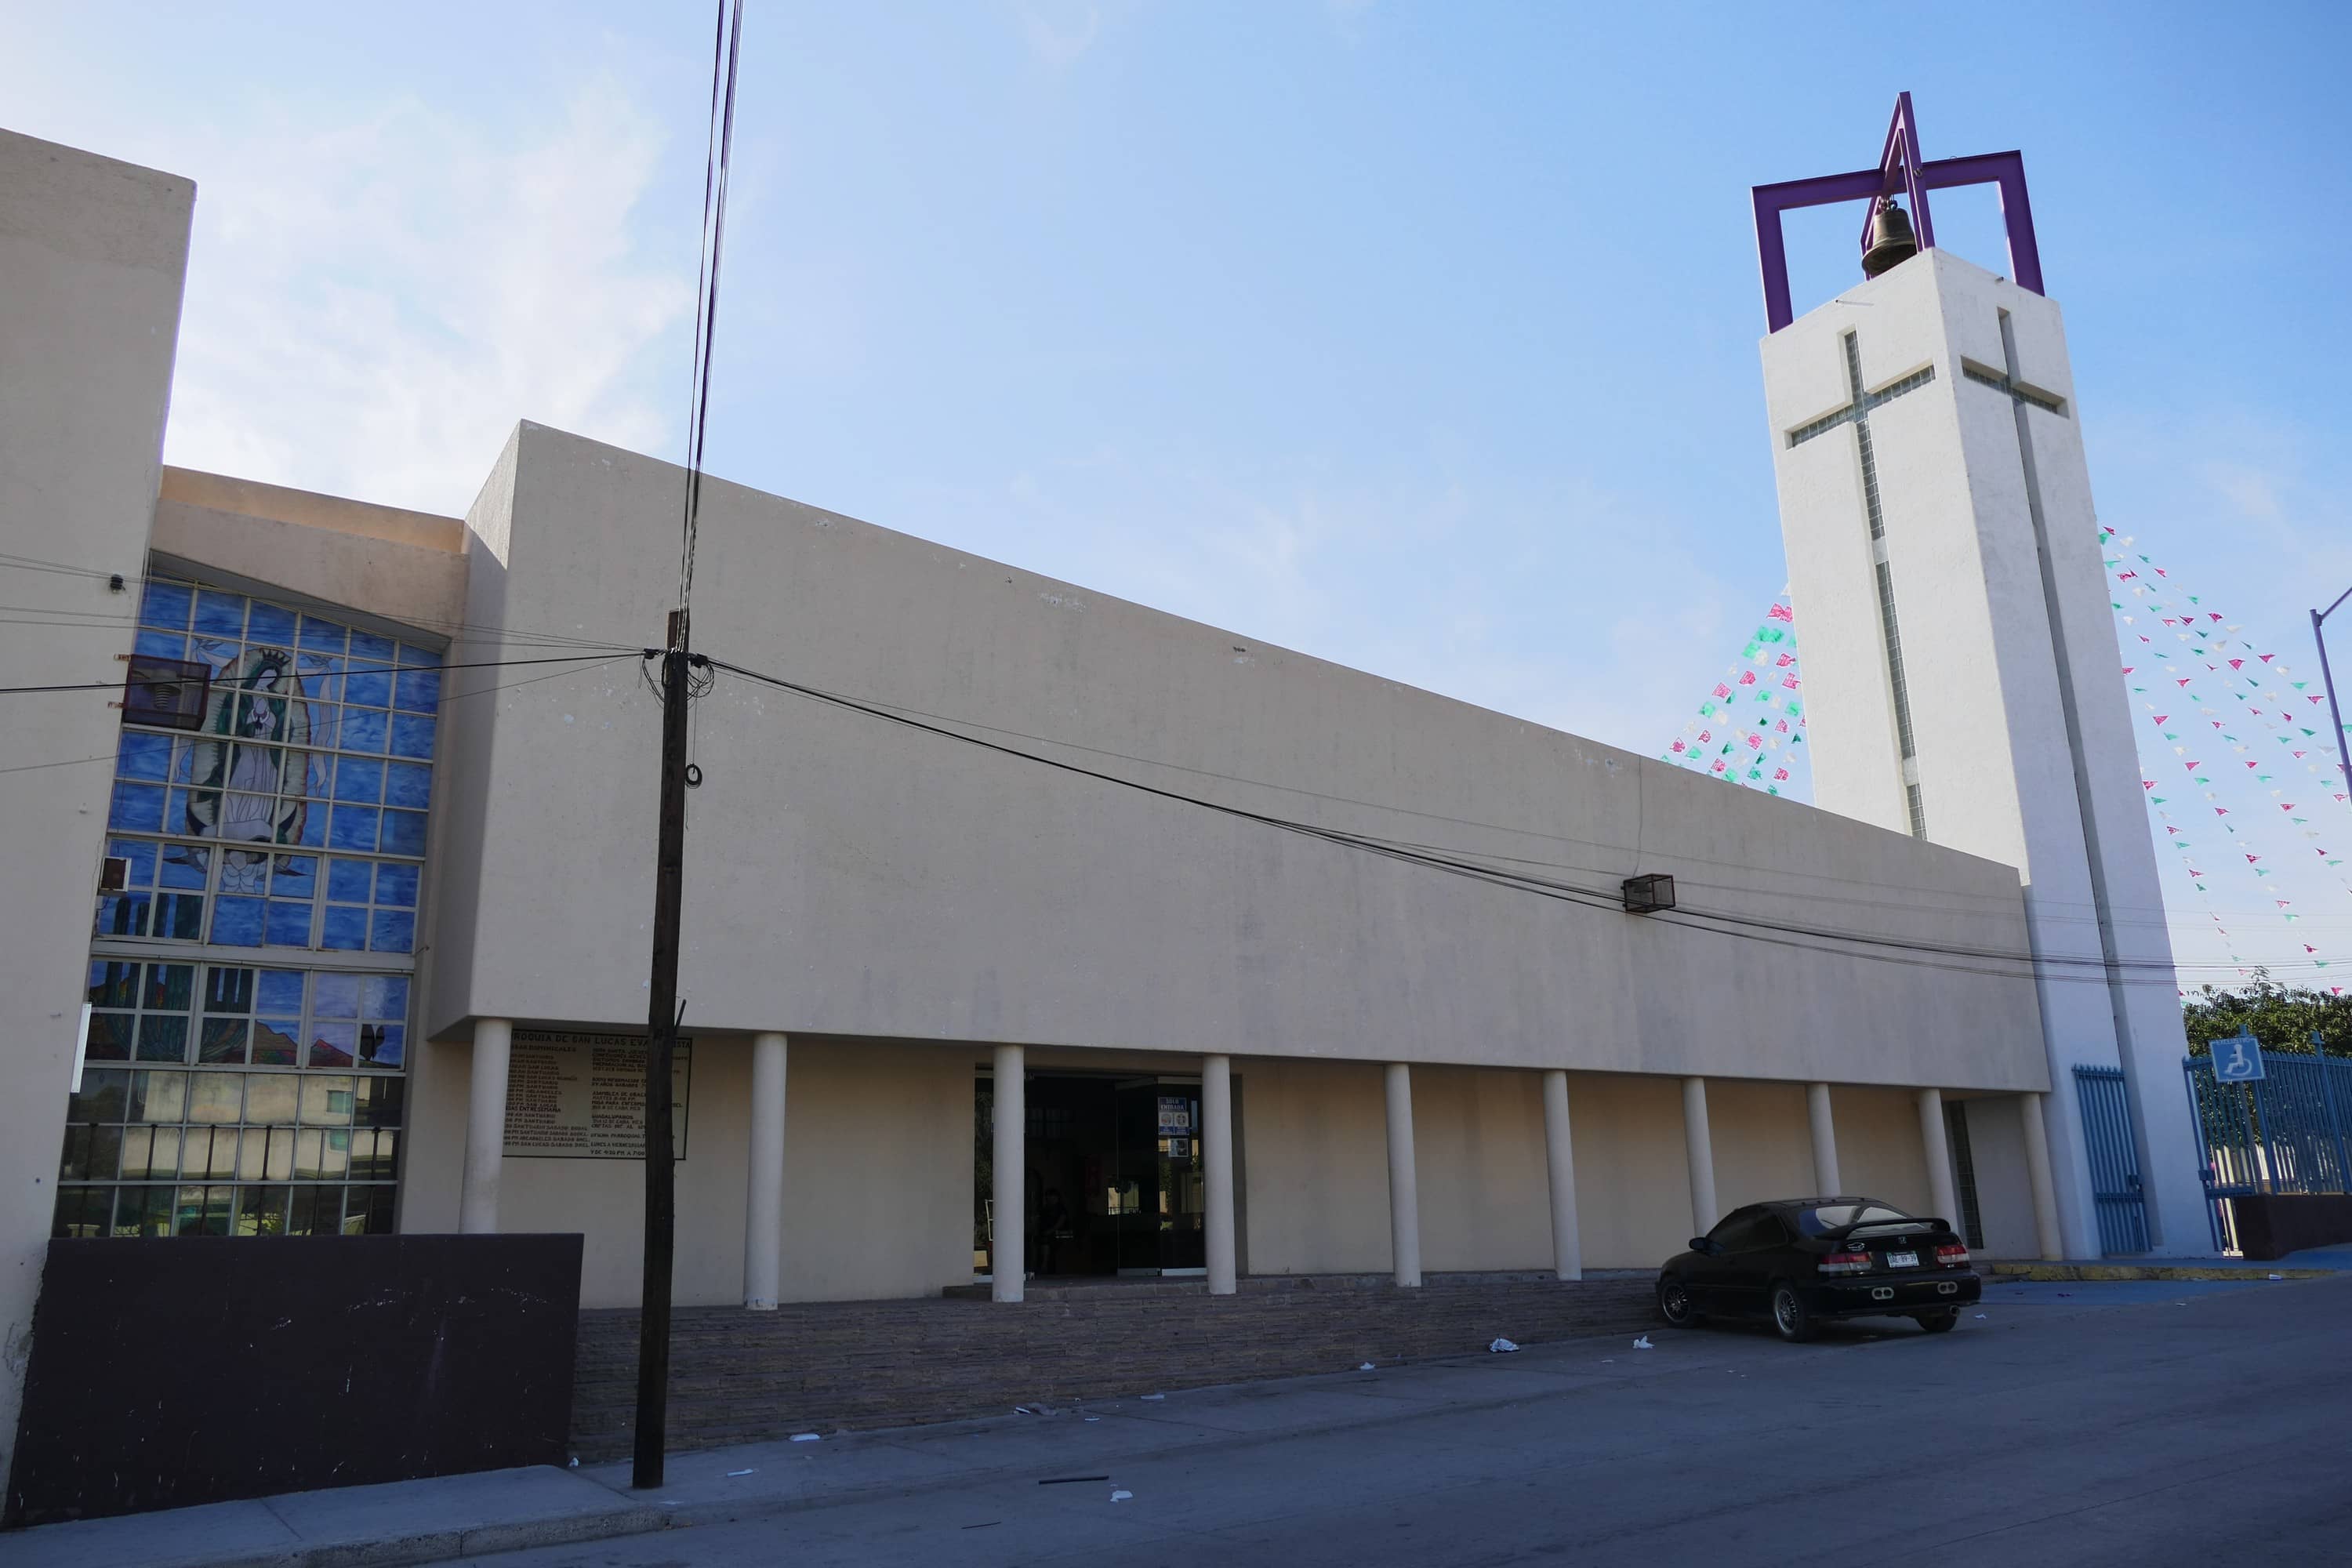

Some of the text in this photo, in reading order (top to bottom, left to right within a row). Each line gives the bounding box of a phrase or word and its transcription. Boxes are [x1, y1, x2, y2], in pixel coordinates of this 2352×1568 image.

[512, 1032, 552, 1042] ROQUIA
[555, 1034, 568, 1043] DE
[572, 1036, 590, 1044] SAN
[595, 1036, 626, 1045] LUCAS
